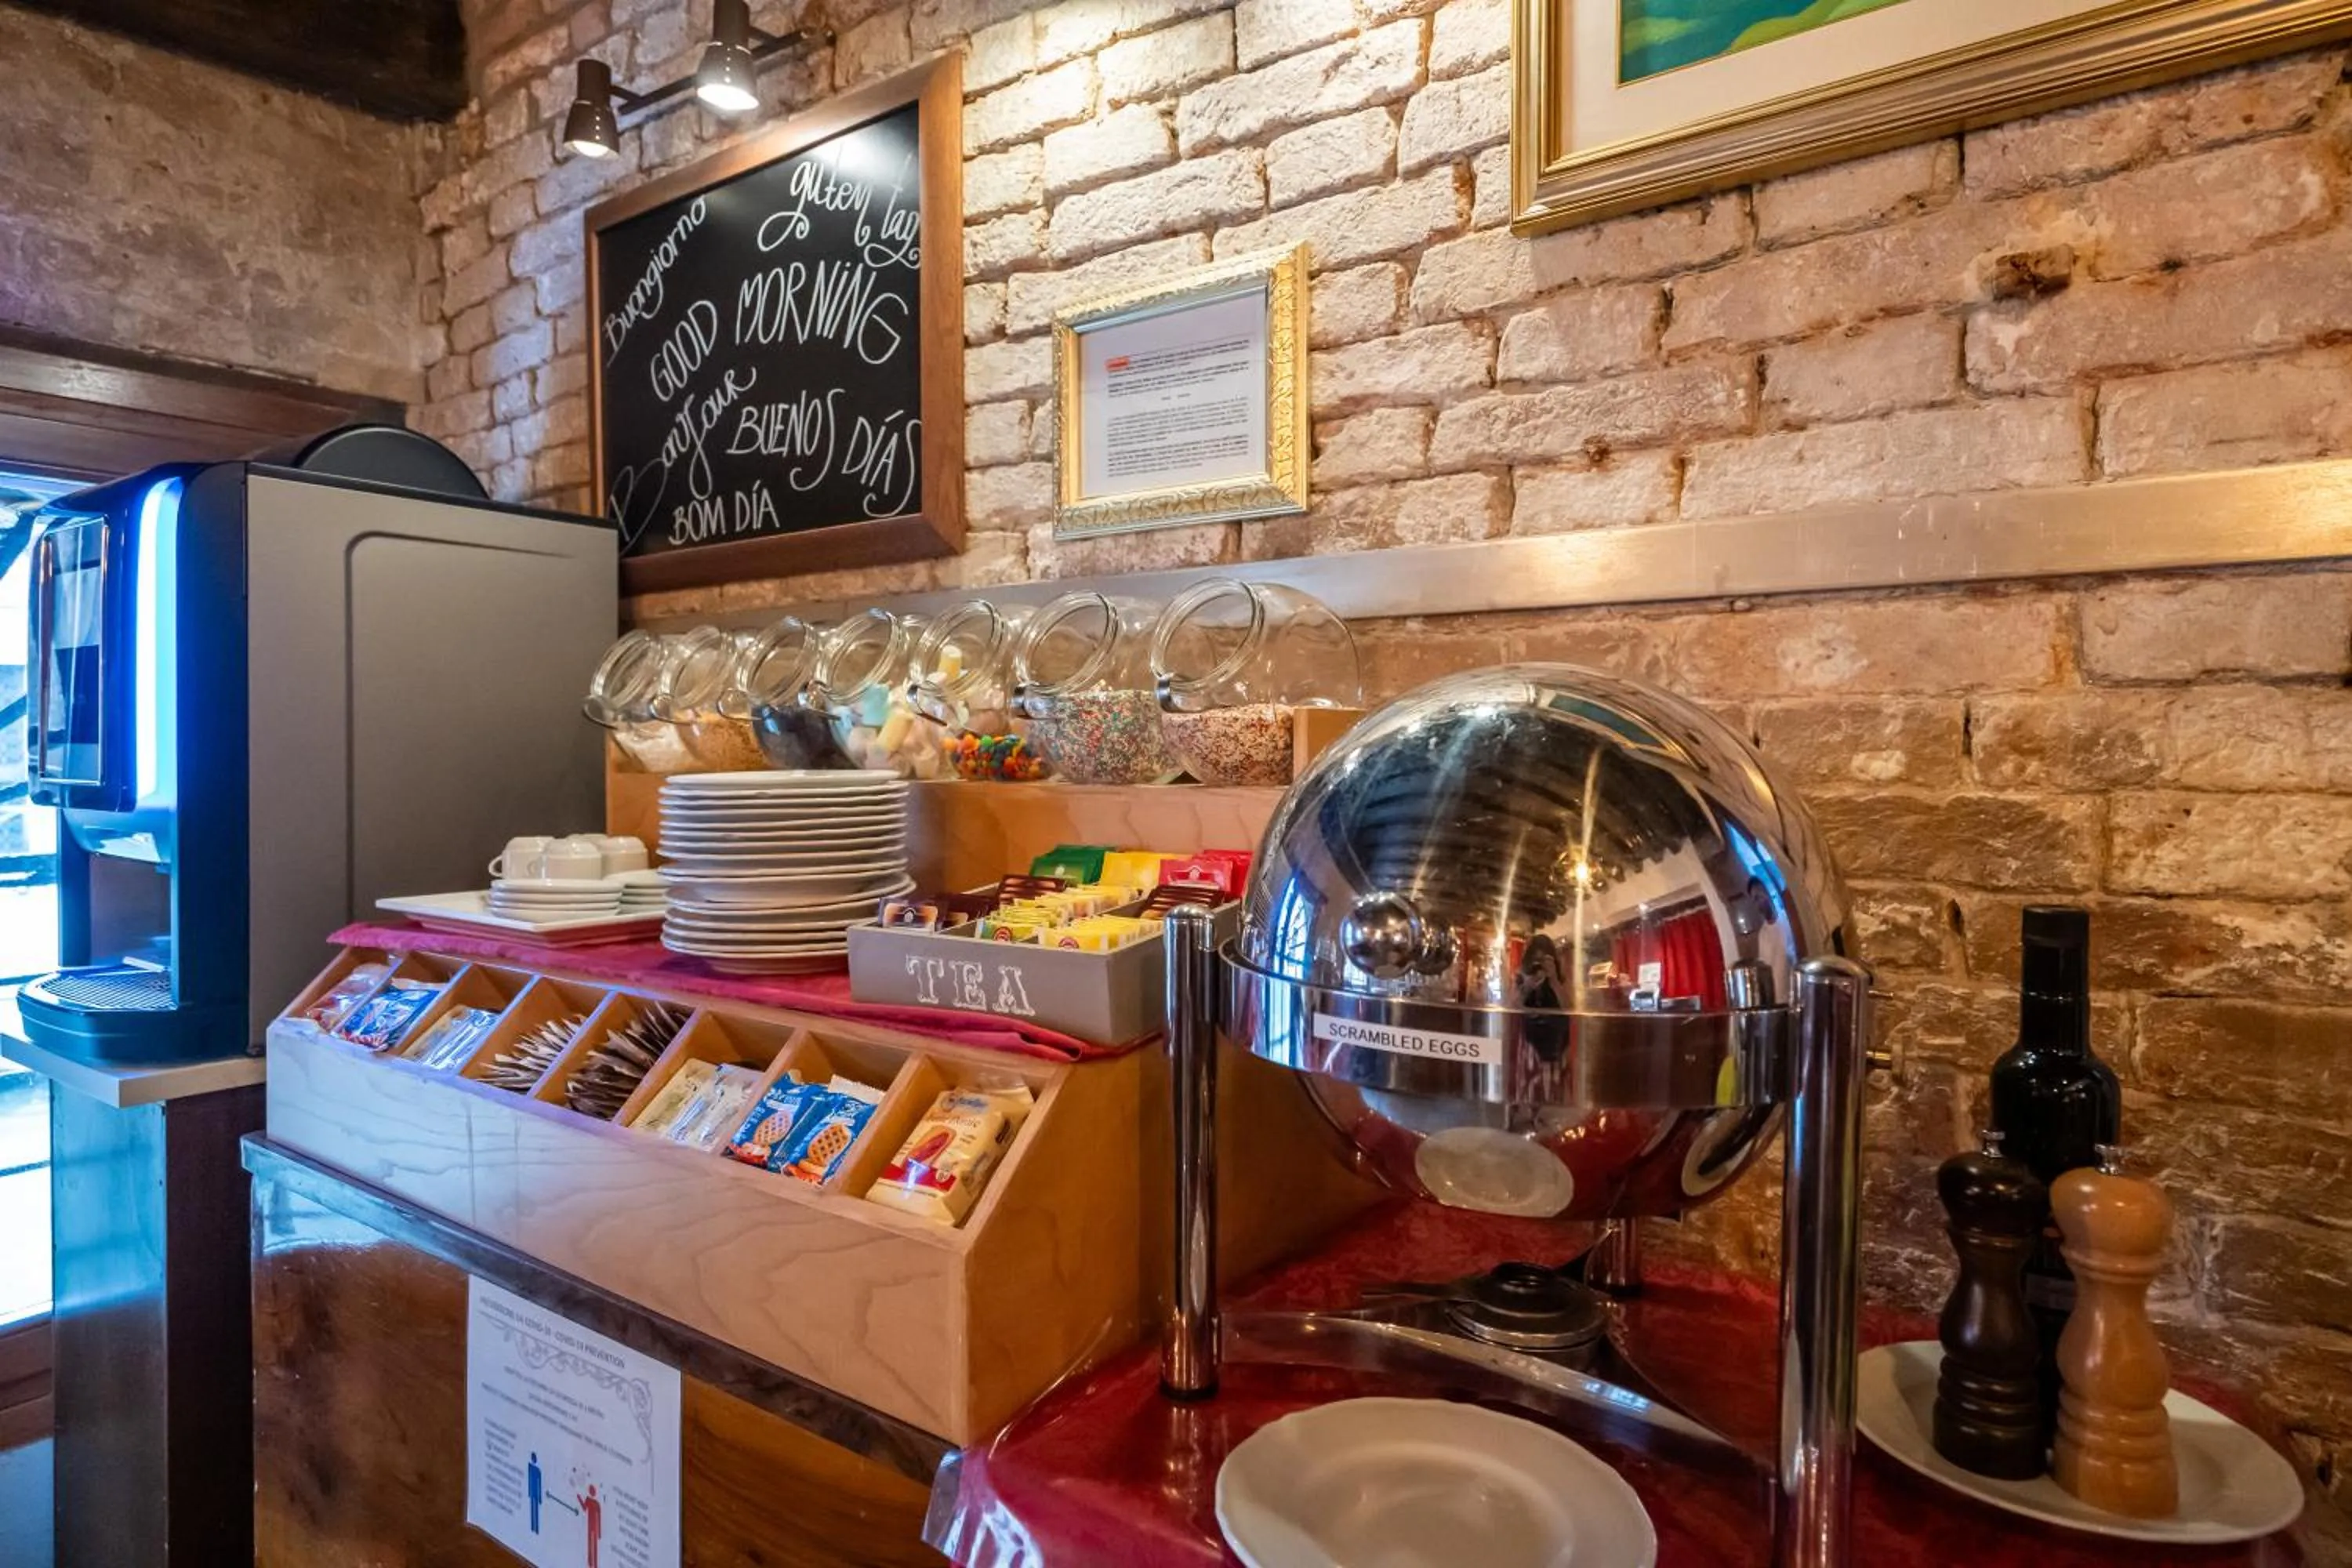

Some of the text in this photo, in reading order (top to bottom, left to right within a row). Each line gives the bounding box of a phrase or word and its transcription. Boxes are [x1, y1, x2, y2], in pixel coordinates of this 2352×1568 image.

[603, 194, 706, 367] Buongiorno
[651, 300, 717, 401] GOOD
[726, 389, 922, 517] BUENOS DÍAS
[669, 494, 726, 545] BOM
[905, 954, 1036, 1016] TEA
[1329, 1022, 1480, 1058] SCRAMBLED EGGS
